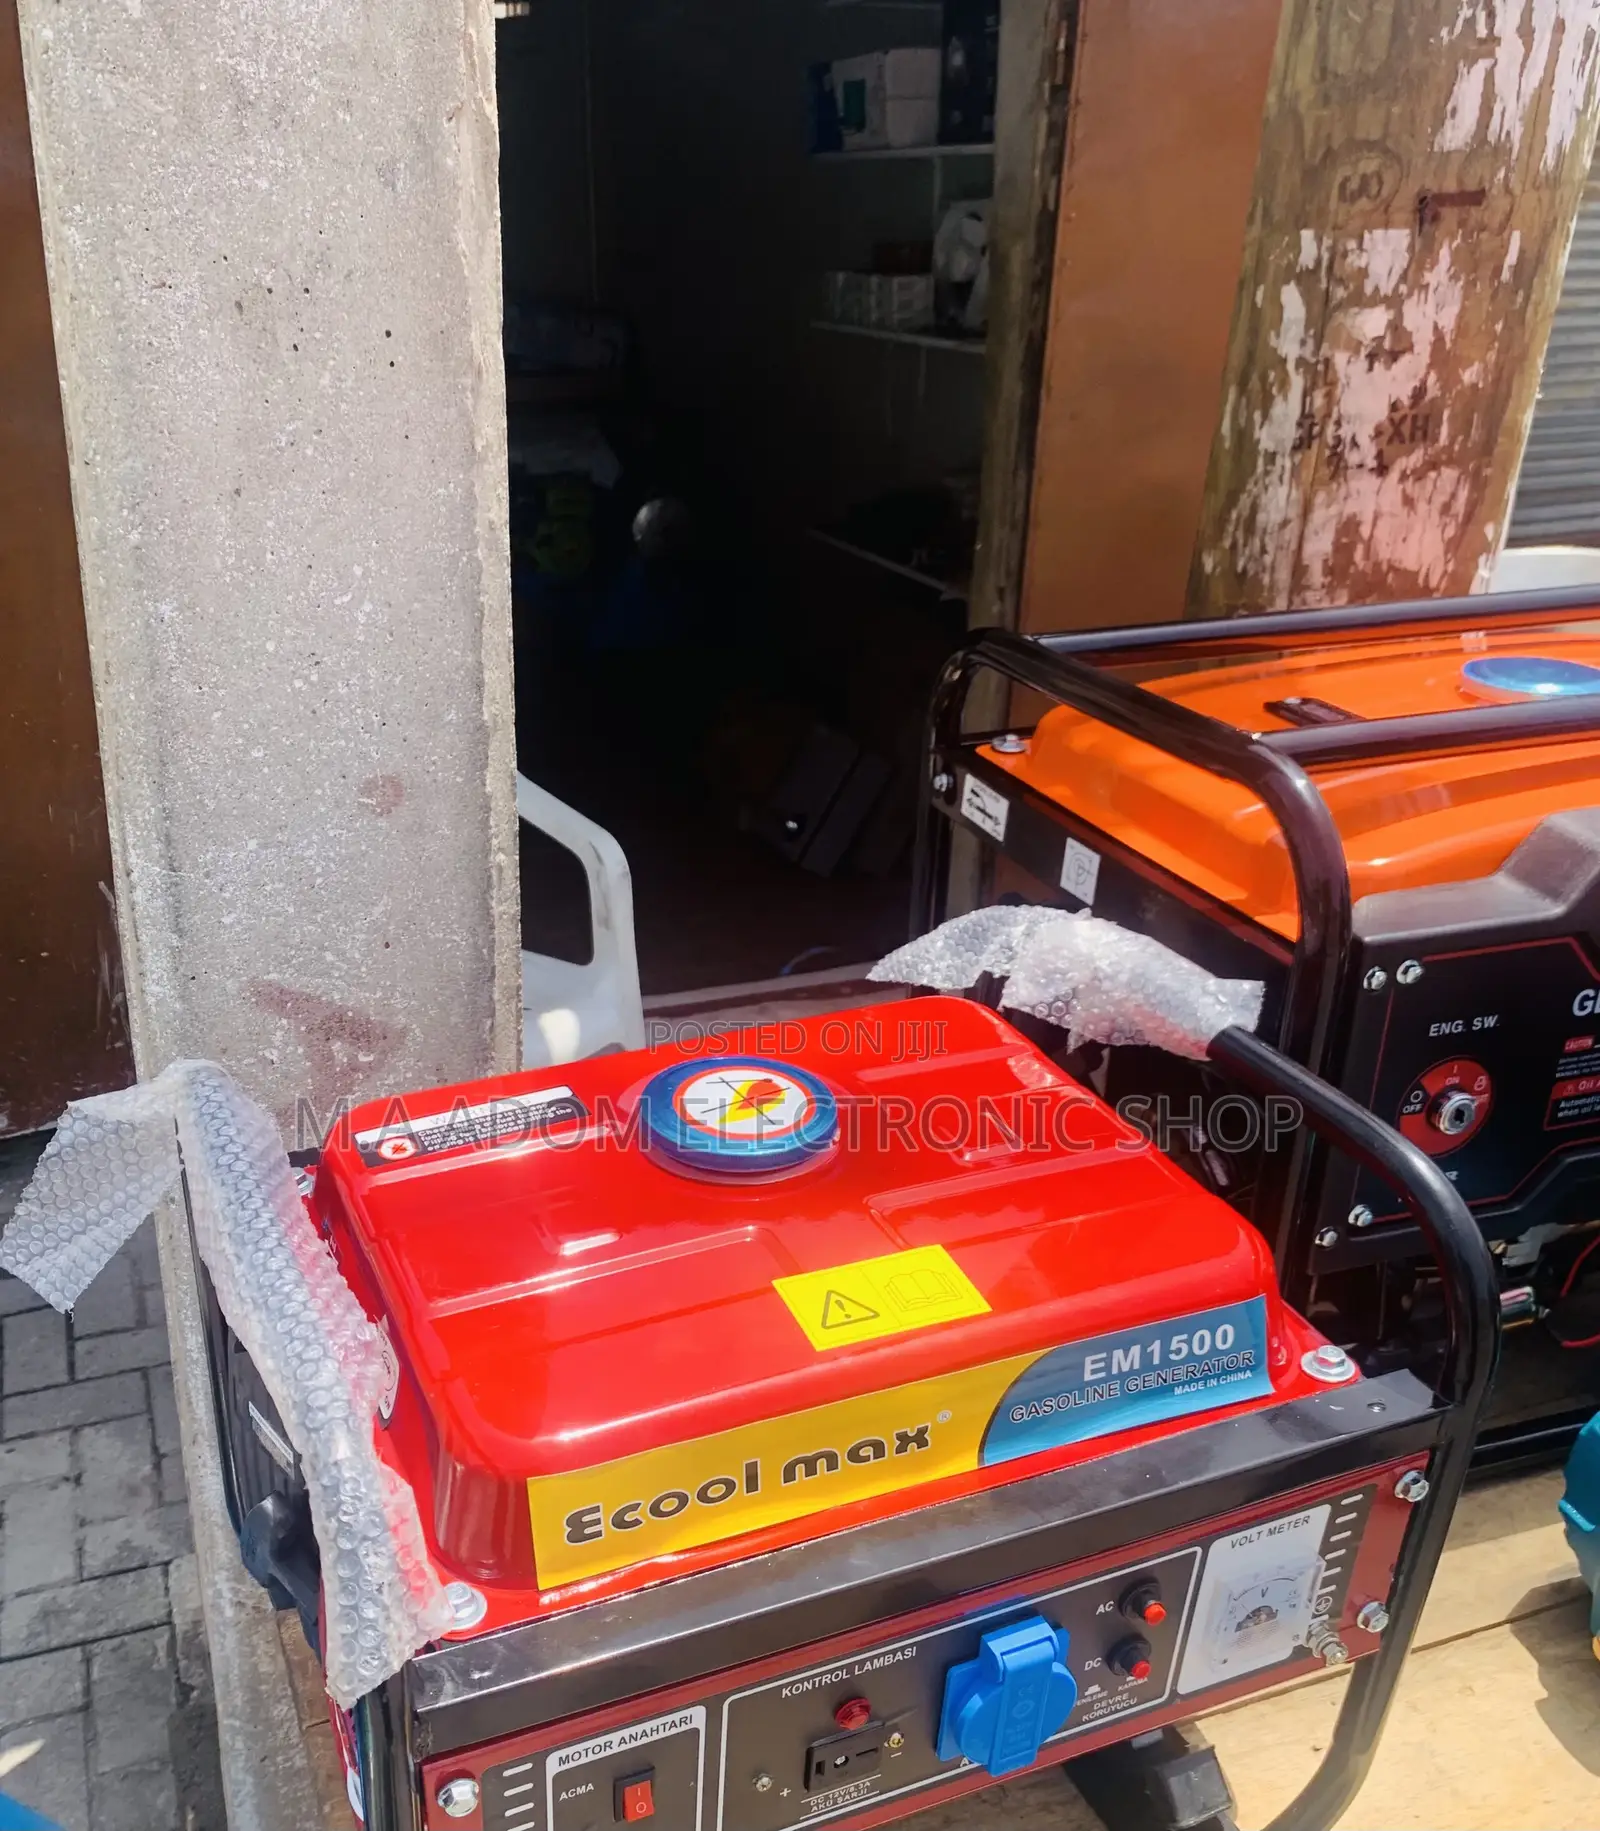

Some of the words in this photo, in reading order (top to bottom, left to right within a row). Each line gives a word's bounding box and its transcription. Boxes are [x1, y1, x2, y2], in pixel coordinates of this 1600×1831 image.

[1429, 1020, 1466, 1037] ENG.
[1472, 1014, 1500, 1031] SW.
[1445, 1076, 1460, 1086] ON
[1402, 1102, 1423, 1115] OFF
[1083, 1323, 1236, 1382] EM1500
[1009, 1380, 1122, 1423] GASOLINE
[1124, 1350, 1256, 1394] GENERATOR
[1174, 1379, 1206, 1396] MADE
[1206, 1377, 1218, 1389] IN
[1218, 1370, 1253, 1387] CHINA
[564, 1458, 761, 1546] Ecool
[780, 1422, 932, 1486] max
[1230, 1531, 1264, 1549] VOLT
[1266, 1515, 1311, 1537] METER
[1260, 1586, 1269, 1598] V
[1096, 1600, 1115, 1616] AC
[781, 1667, 851, 1699] KONTROL
[854, 1646, 917, 1676] LAMBASI
[1084, 1657, 1102, 1671] DC
[1082, 1696, 1138, 1722] KORUYUCU
[1094, 1692, 1130, 1710] DEVRE
[558, 1740, 613, 1767] MOTOR
[617, 1714, 694, 1748] ANAHTARI
[558, 1783, 595, 1802] ACMA
[810, 1796, 825, 1806] DC
